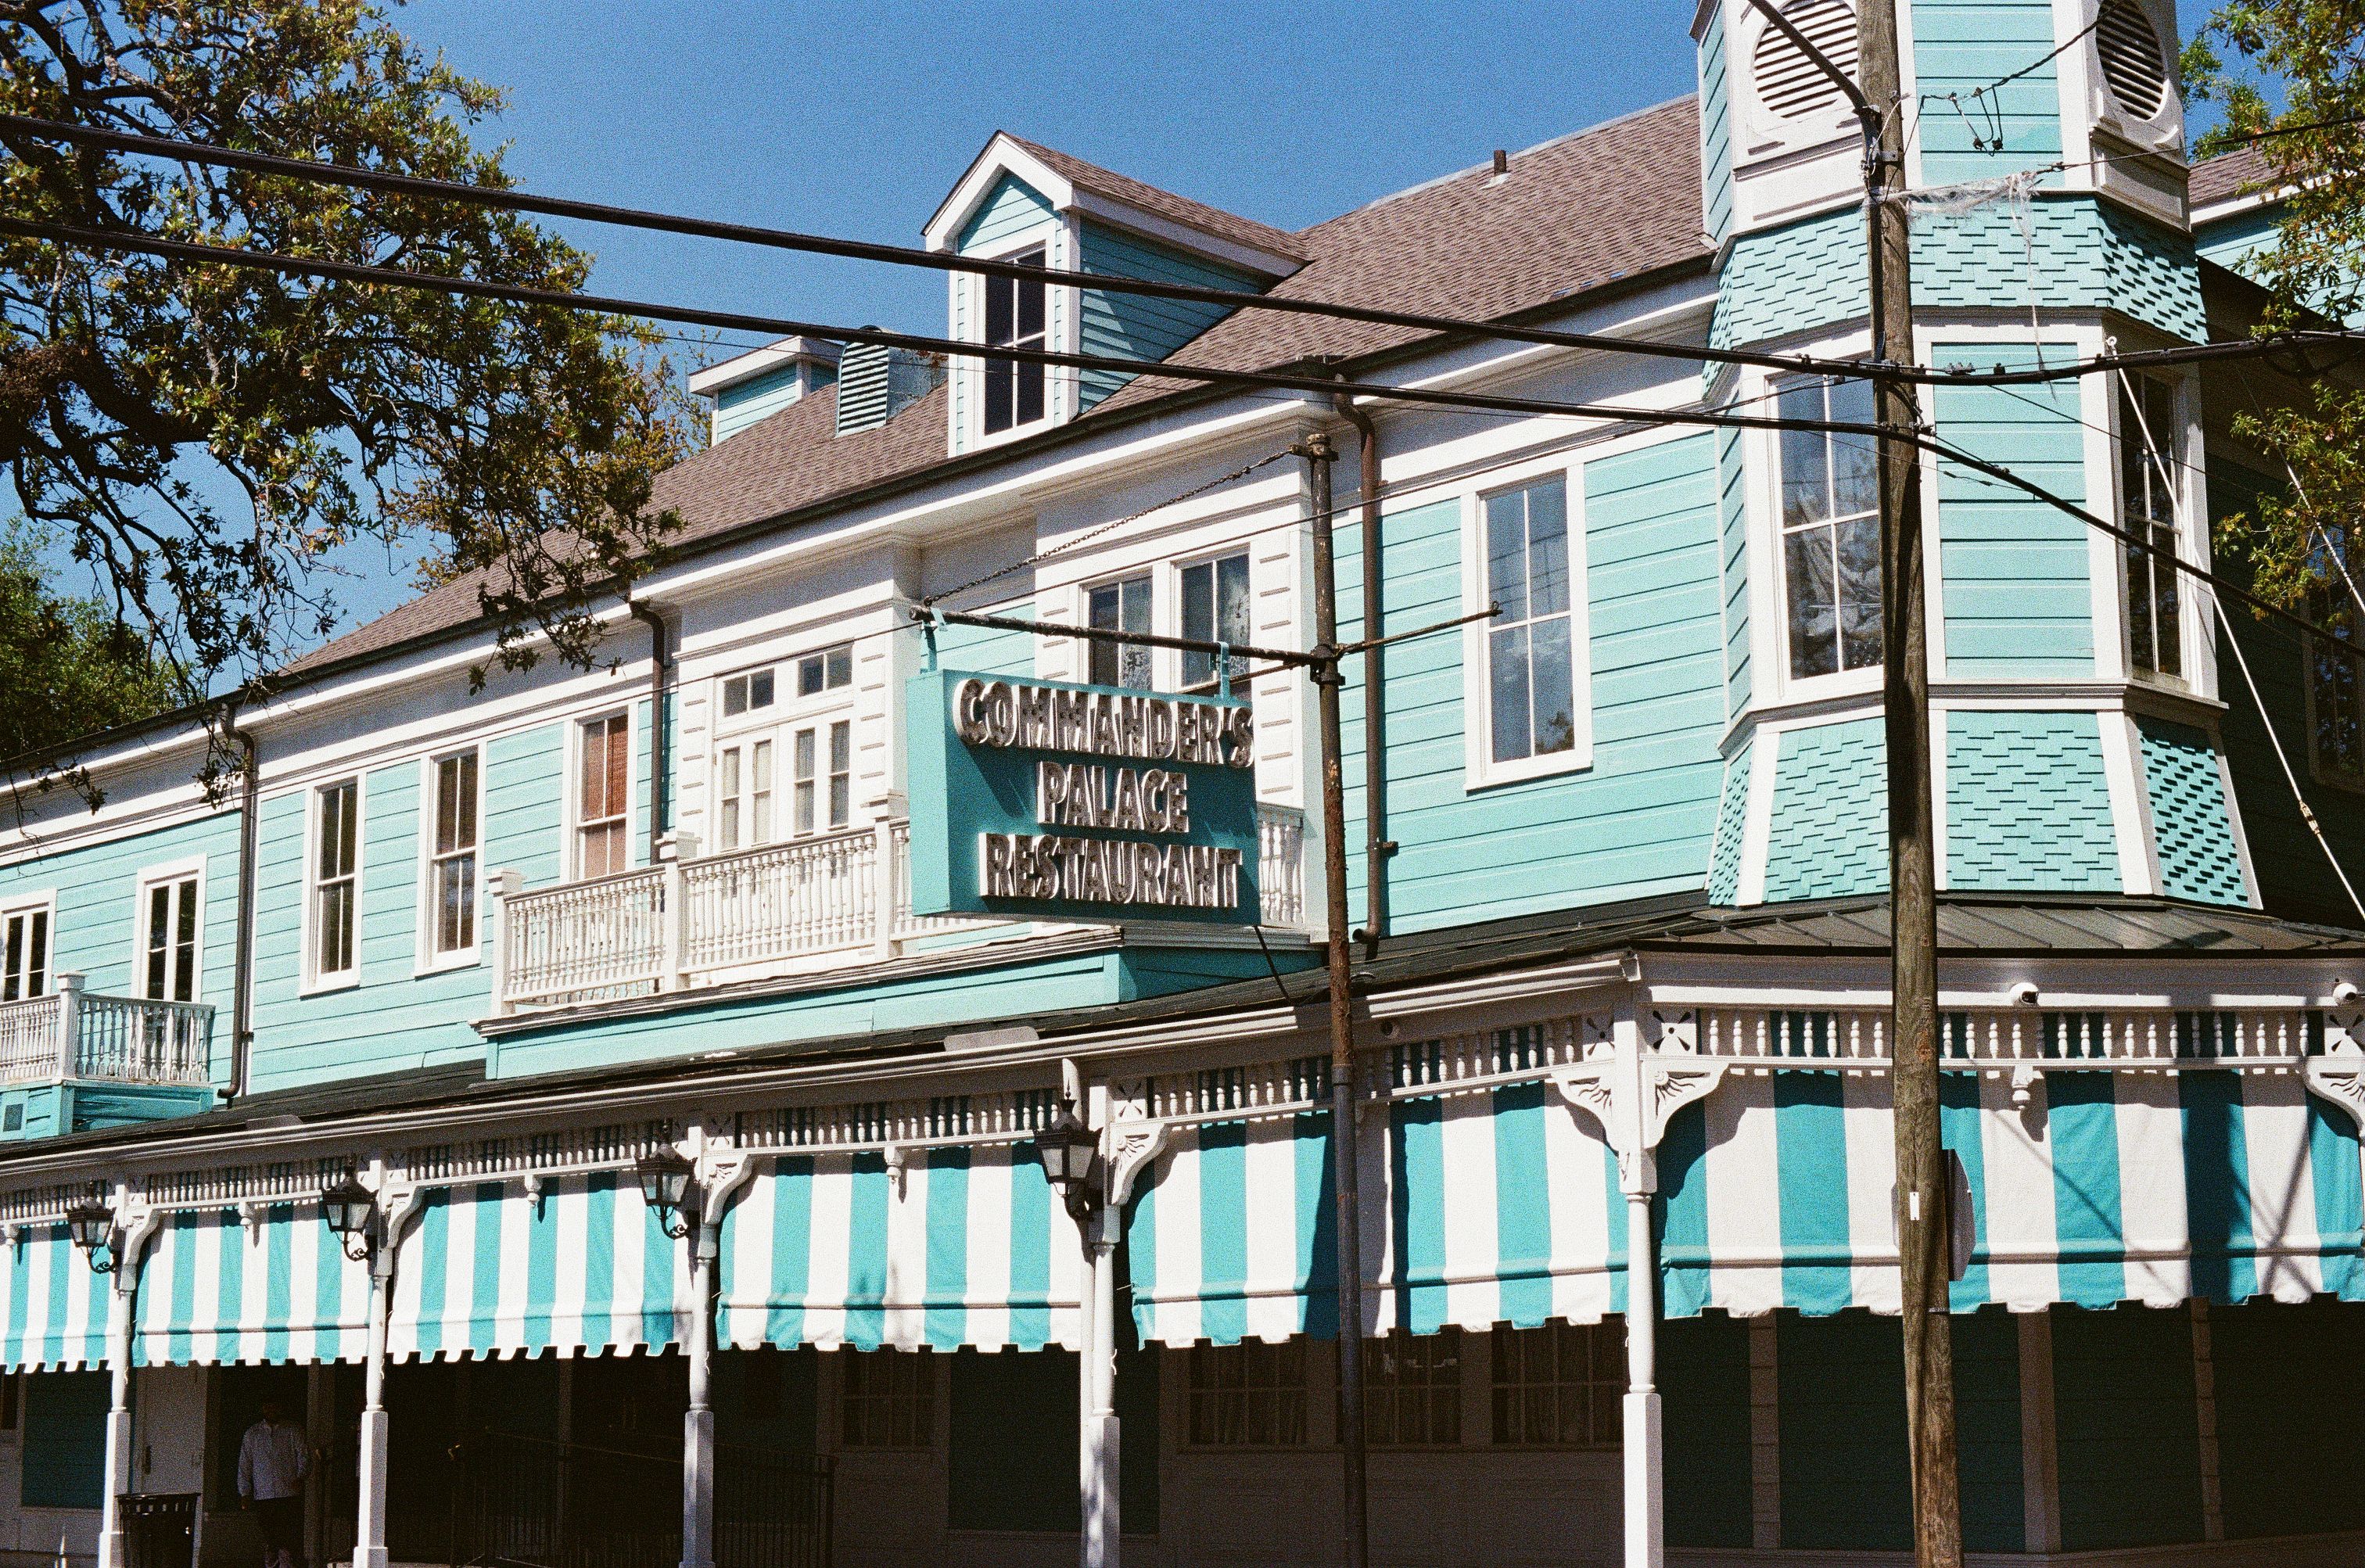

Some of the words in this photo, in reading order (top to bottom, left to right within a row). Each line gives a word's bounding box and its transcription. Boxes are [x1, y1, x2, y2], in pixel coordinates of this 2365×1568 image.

[953, 678, 1254, 768] COMMANDER'S
[1037, 760, 1190, 833] PALACE
[978, 832, 1243, 908] RESTAURANT
